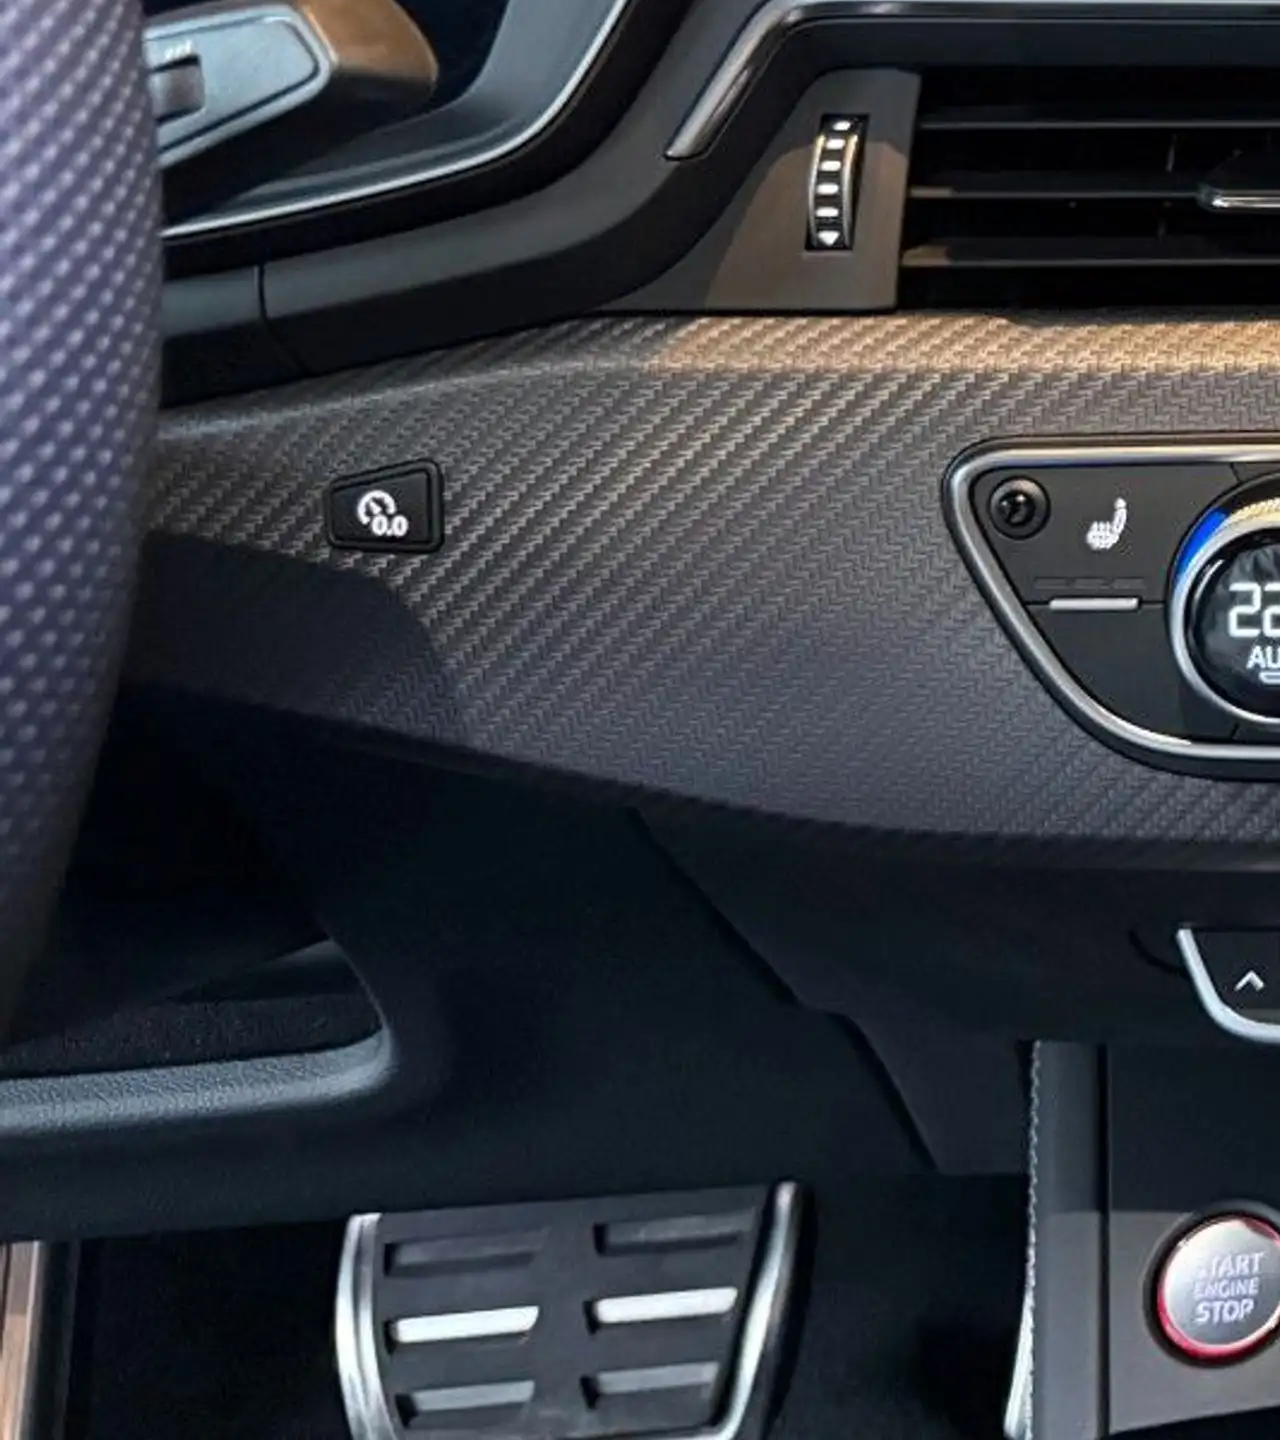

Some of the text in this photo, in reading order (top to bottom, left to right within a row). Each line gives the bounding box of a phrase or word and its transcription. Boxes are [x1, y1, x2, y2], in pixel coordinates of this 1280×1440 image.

[371, 515, 408, 537] 0.0
[1194, 1276, 1259, 1300] ENGINE
[1195, 1298, 1255, 1325] STOP
